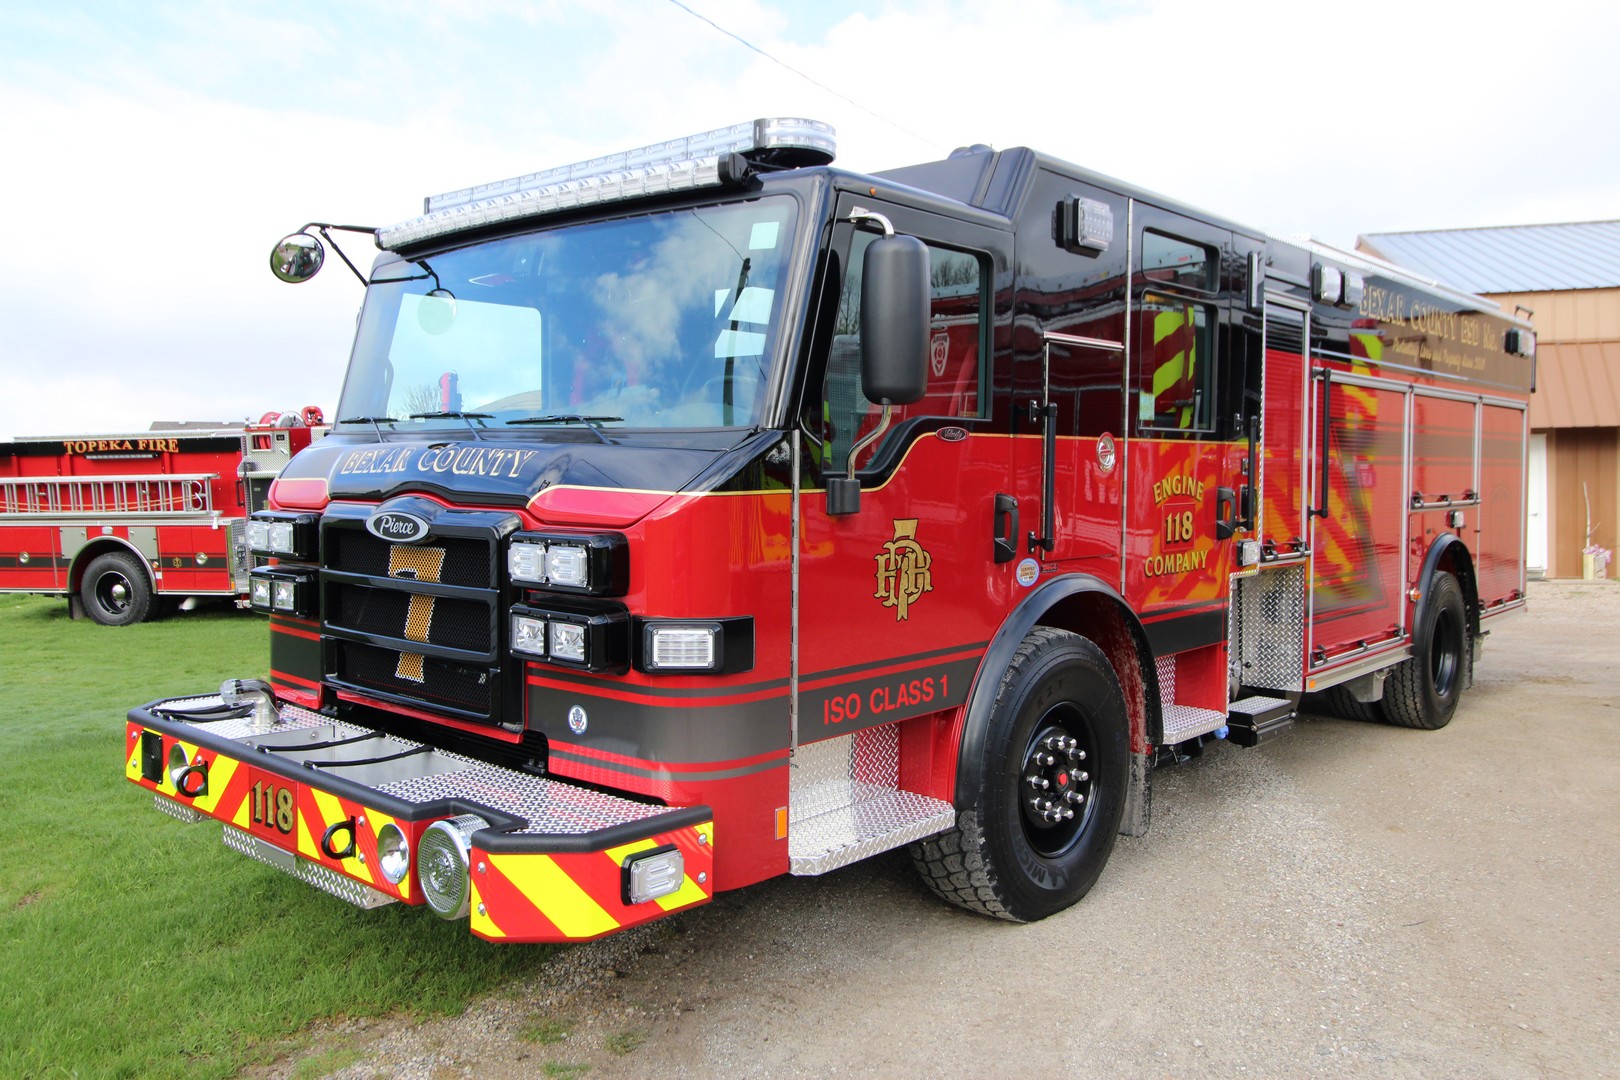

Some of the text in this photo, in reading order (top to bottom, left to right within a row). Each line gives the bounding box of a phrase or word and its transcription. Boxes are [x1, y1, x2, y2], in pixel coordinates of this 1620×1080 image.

[1359, 285, 1406, 327] BEXAR
[1411, 302, 1458, 341] COUNTY
[1461, 315, 1479, 346] ESD
[63, 438, 179, 455] TOPEKA FIRE
[340, 446, 539, 477] BEXAR COUNTY
[1152, 475, 1204, 504] ENGINE
[379, 515, 414, 535] Pierce
[1165, 511, 1193, 543] 118
[1144, 550, 1208, 577] COMPANY
[823, 674, 948, 725] ISO CLASS 1
[251, 779, 294, 835] 118
